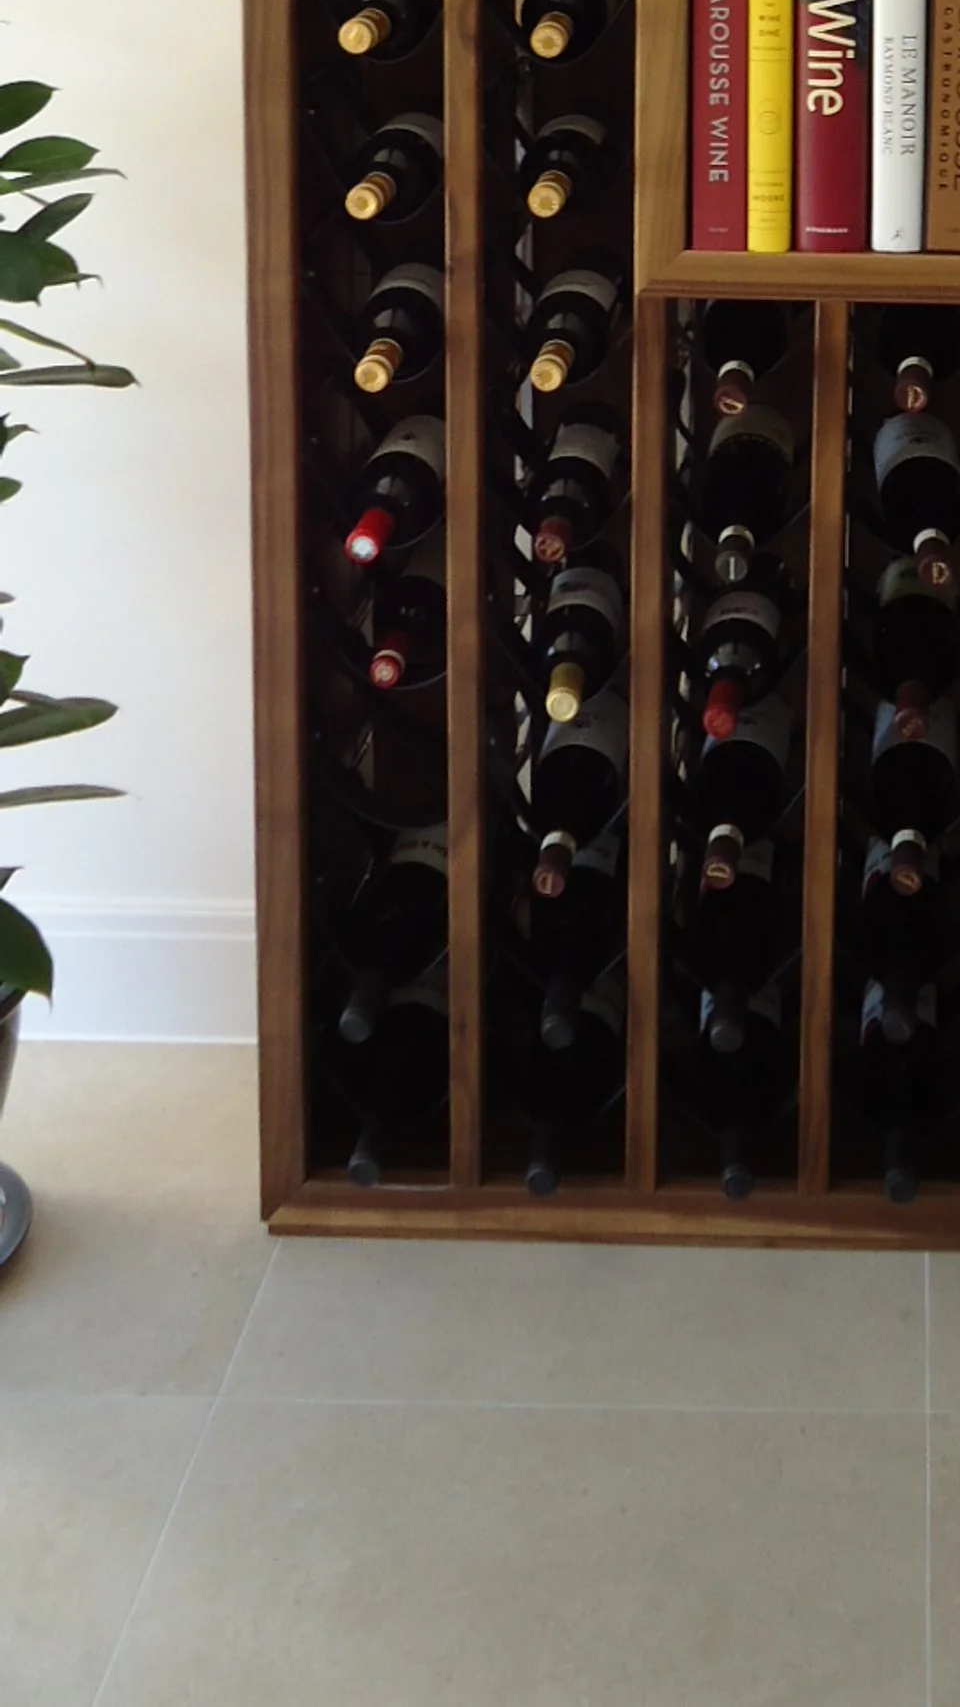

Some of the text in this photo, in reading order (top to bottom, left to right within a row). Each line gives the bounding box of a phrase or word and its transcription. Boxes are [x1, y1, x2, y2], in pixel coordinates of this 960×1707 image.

[708, 118, 729, 183] WINE
[882, 36, 894, 156] RAYMOND BLANC
[900, 35, 917, 156] LE MANOIR
[938, 7, 952, 191] GASTRONOMIQUE
